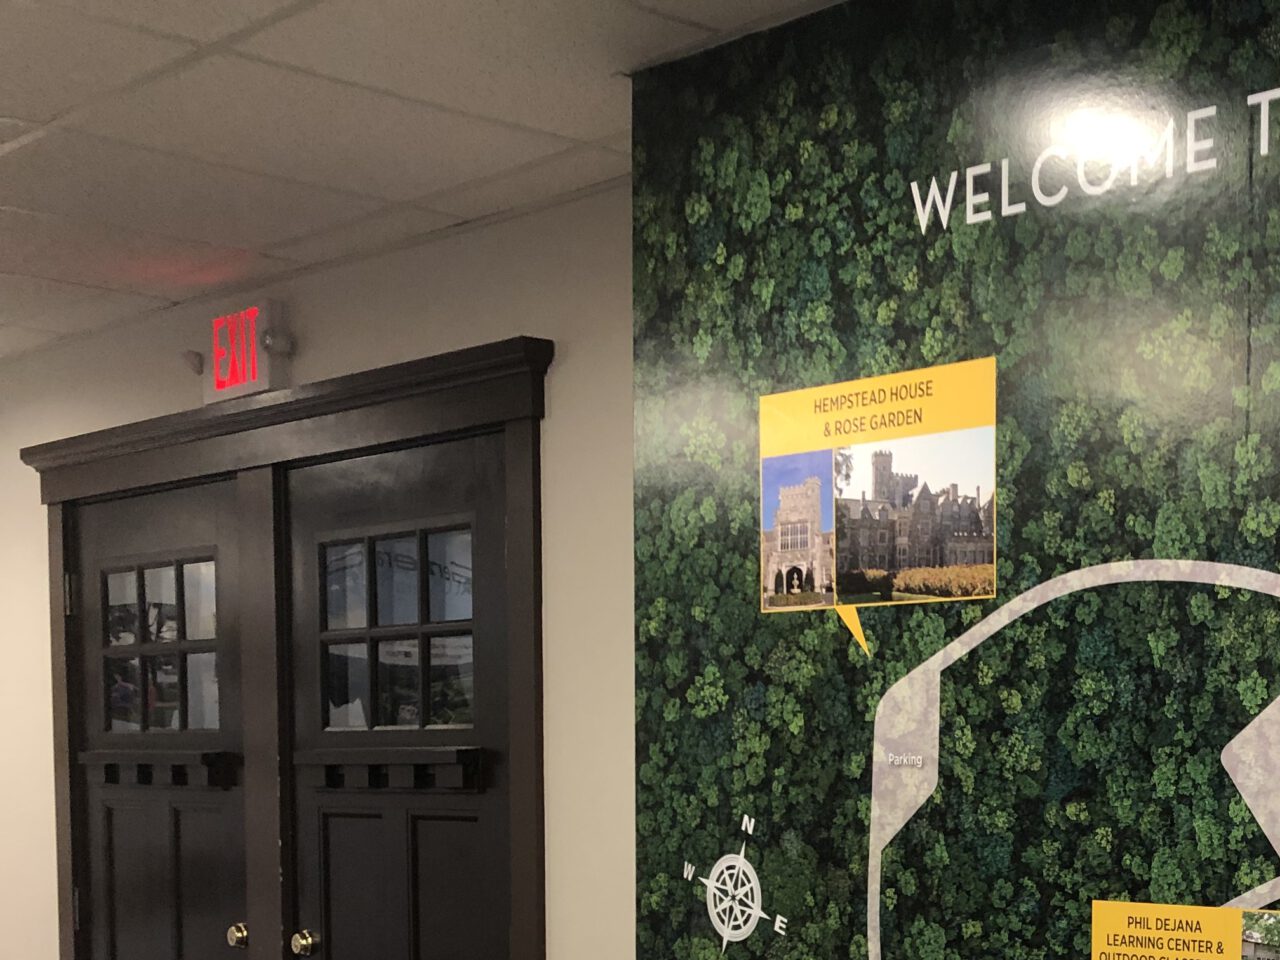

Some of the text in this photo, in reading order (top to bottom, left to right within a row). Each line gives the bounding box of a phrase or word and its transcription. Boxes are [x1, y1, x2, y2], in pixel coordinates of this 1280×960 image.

[910, 105, 1218, 236] WELCOME
[213, 306, 260, 390] EXIT
[814, 380, 934, 414] HEMPSTEAD HOUSE
[823, 408, 923, 437] & ROSE GARDEN
[888, 753, 923, 768] Parking
[741, 814, 755, 835] N
[682, 861, 696, 881] W
[773, 914, 788, 936] E
[1127, 916, 1202, 933] PHIL DEJANA
[1106, 933, 1225, 955] LEARNING CENTER &
